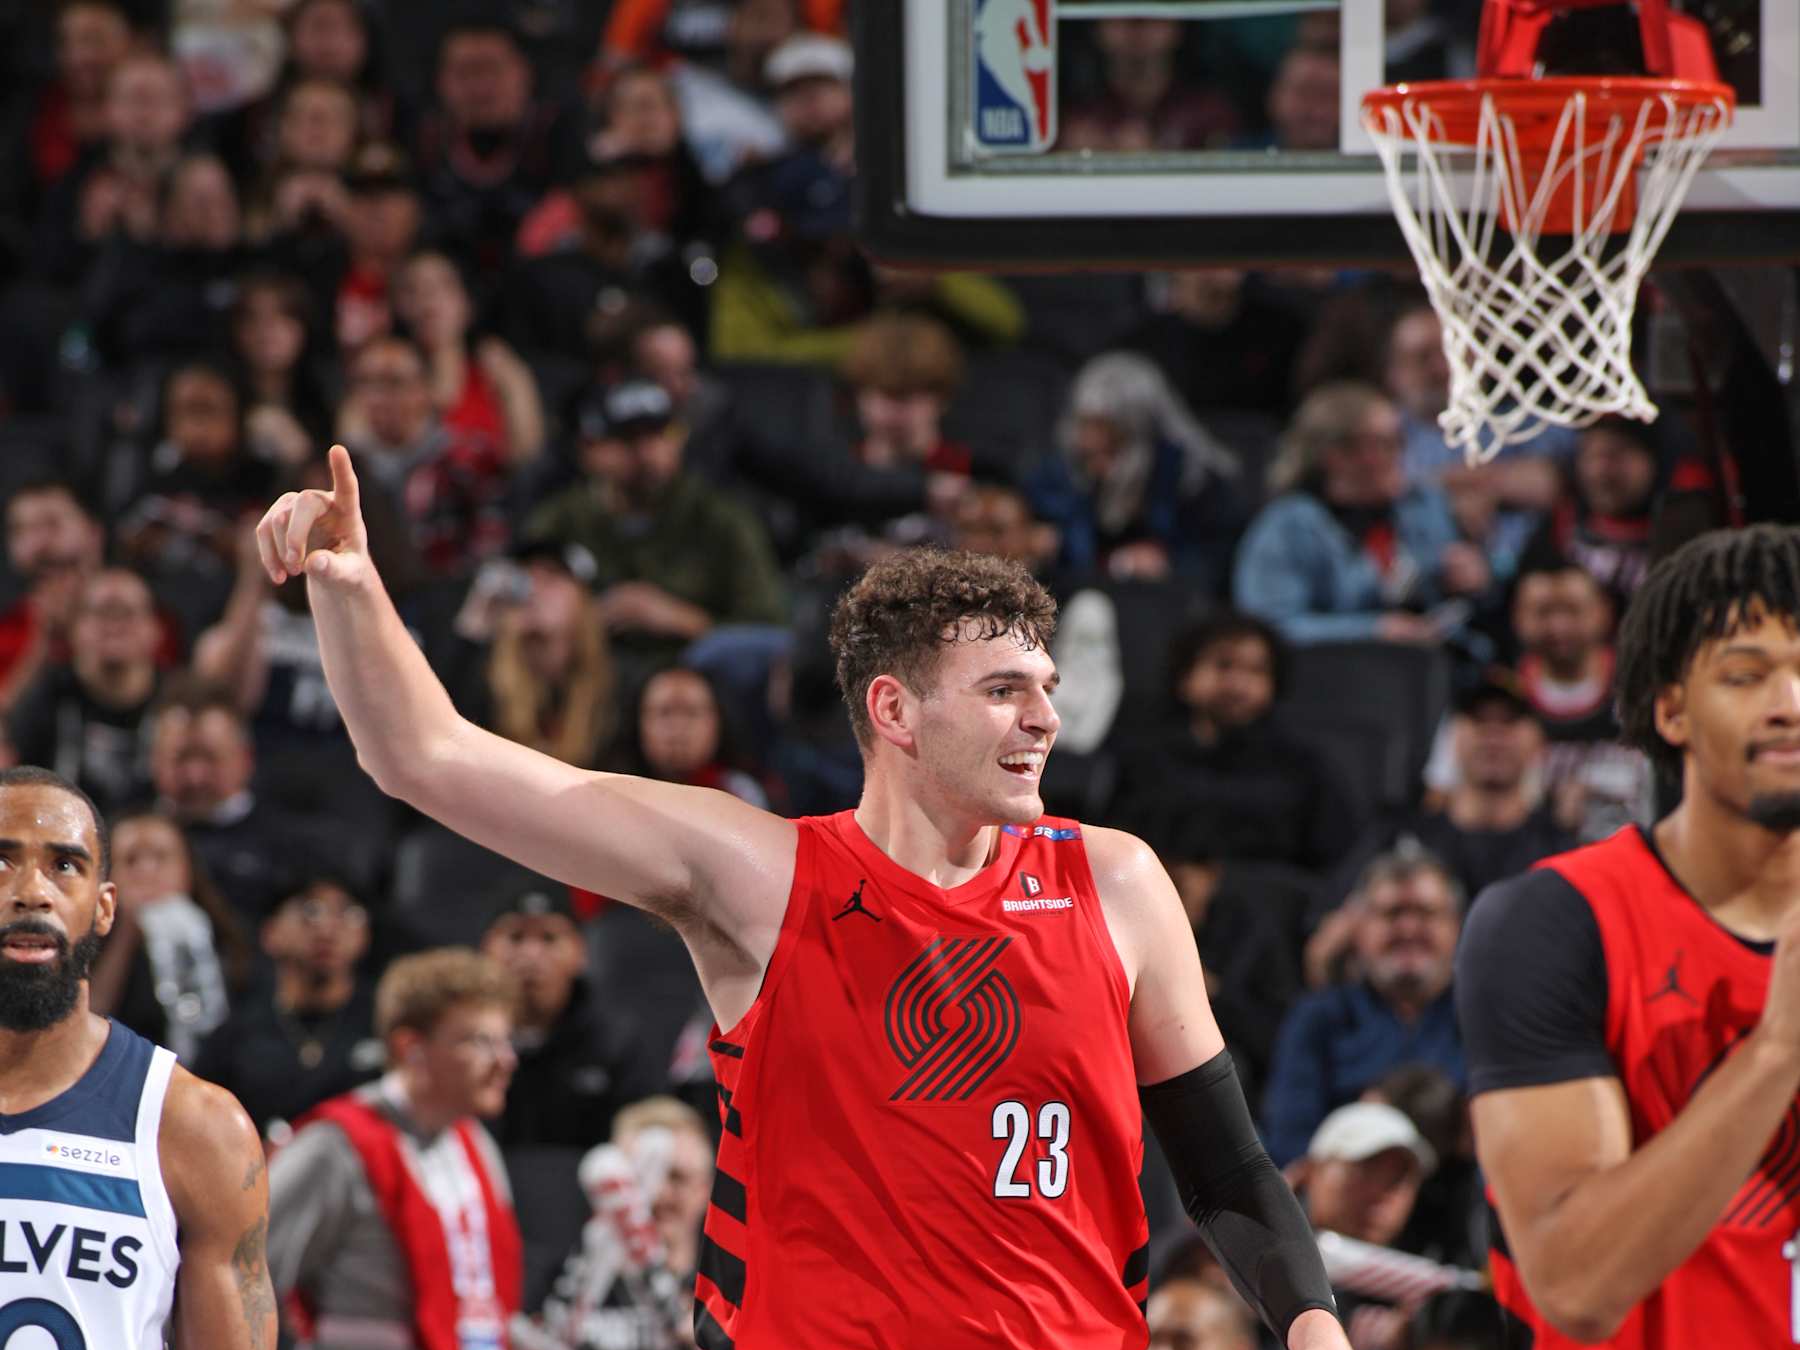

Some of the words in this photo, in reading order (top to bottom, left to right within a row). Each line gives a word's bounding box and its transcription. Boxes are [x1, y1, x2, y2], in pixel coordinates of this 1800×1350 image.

[1026, 876, 1040, 894] B
[1003, 897, 1074, 912] BRIGHTSIDE
[60, 1145, 121, 1166] sezzle
[992, 1100, 1071, 1198] 23
